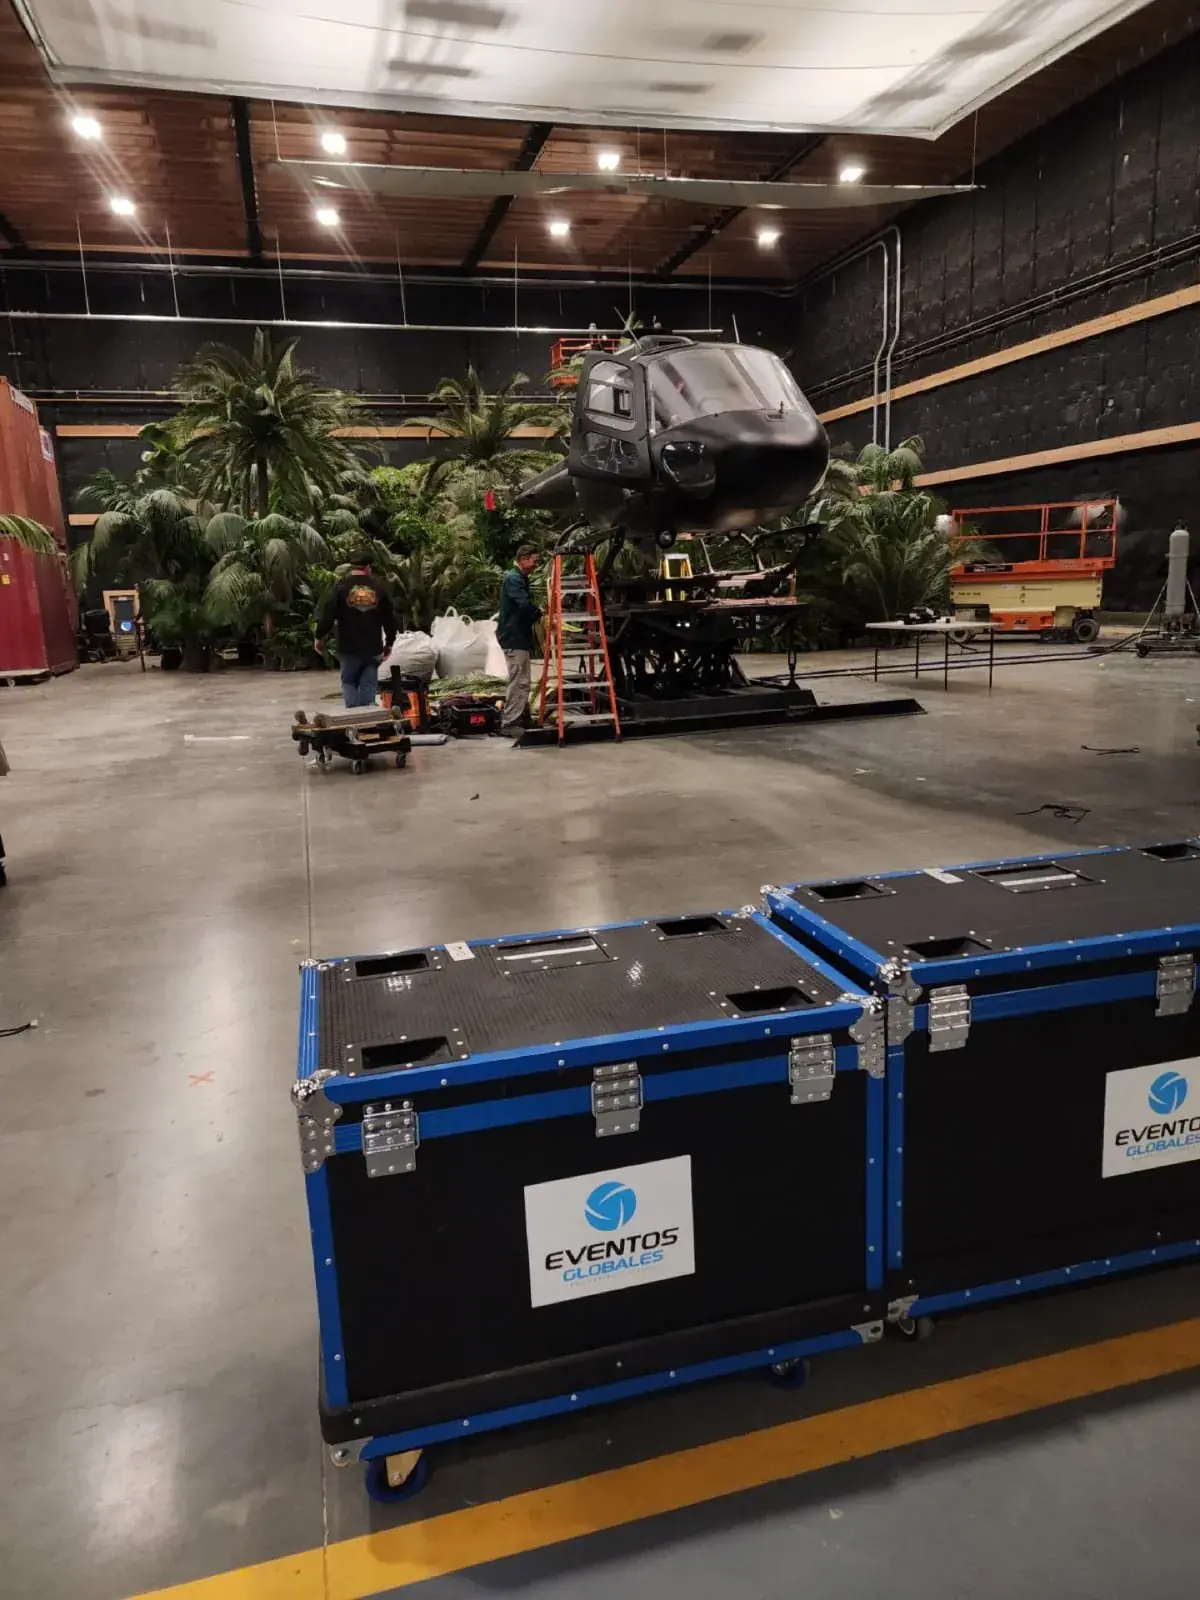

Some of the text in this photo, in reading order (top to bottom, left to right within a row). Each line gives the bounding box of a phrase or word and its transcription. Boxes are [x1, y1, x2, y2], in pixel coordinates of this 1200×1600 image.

[1115, 1116, 1200, 1146] EVENTO
[545, 1227, 680, 1270] EVENTOS
[563, 1249, 664, 1282] GLOBALES
